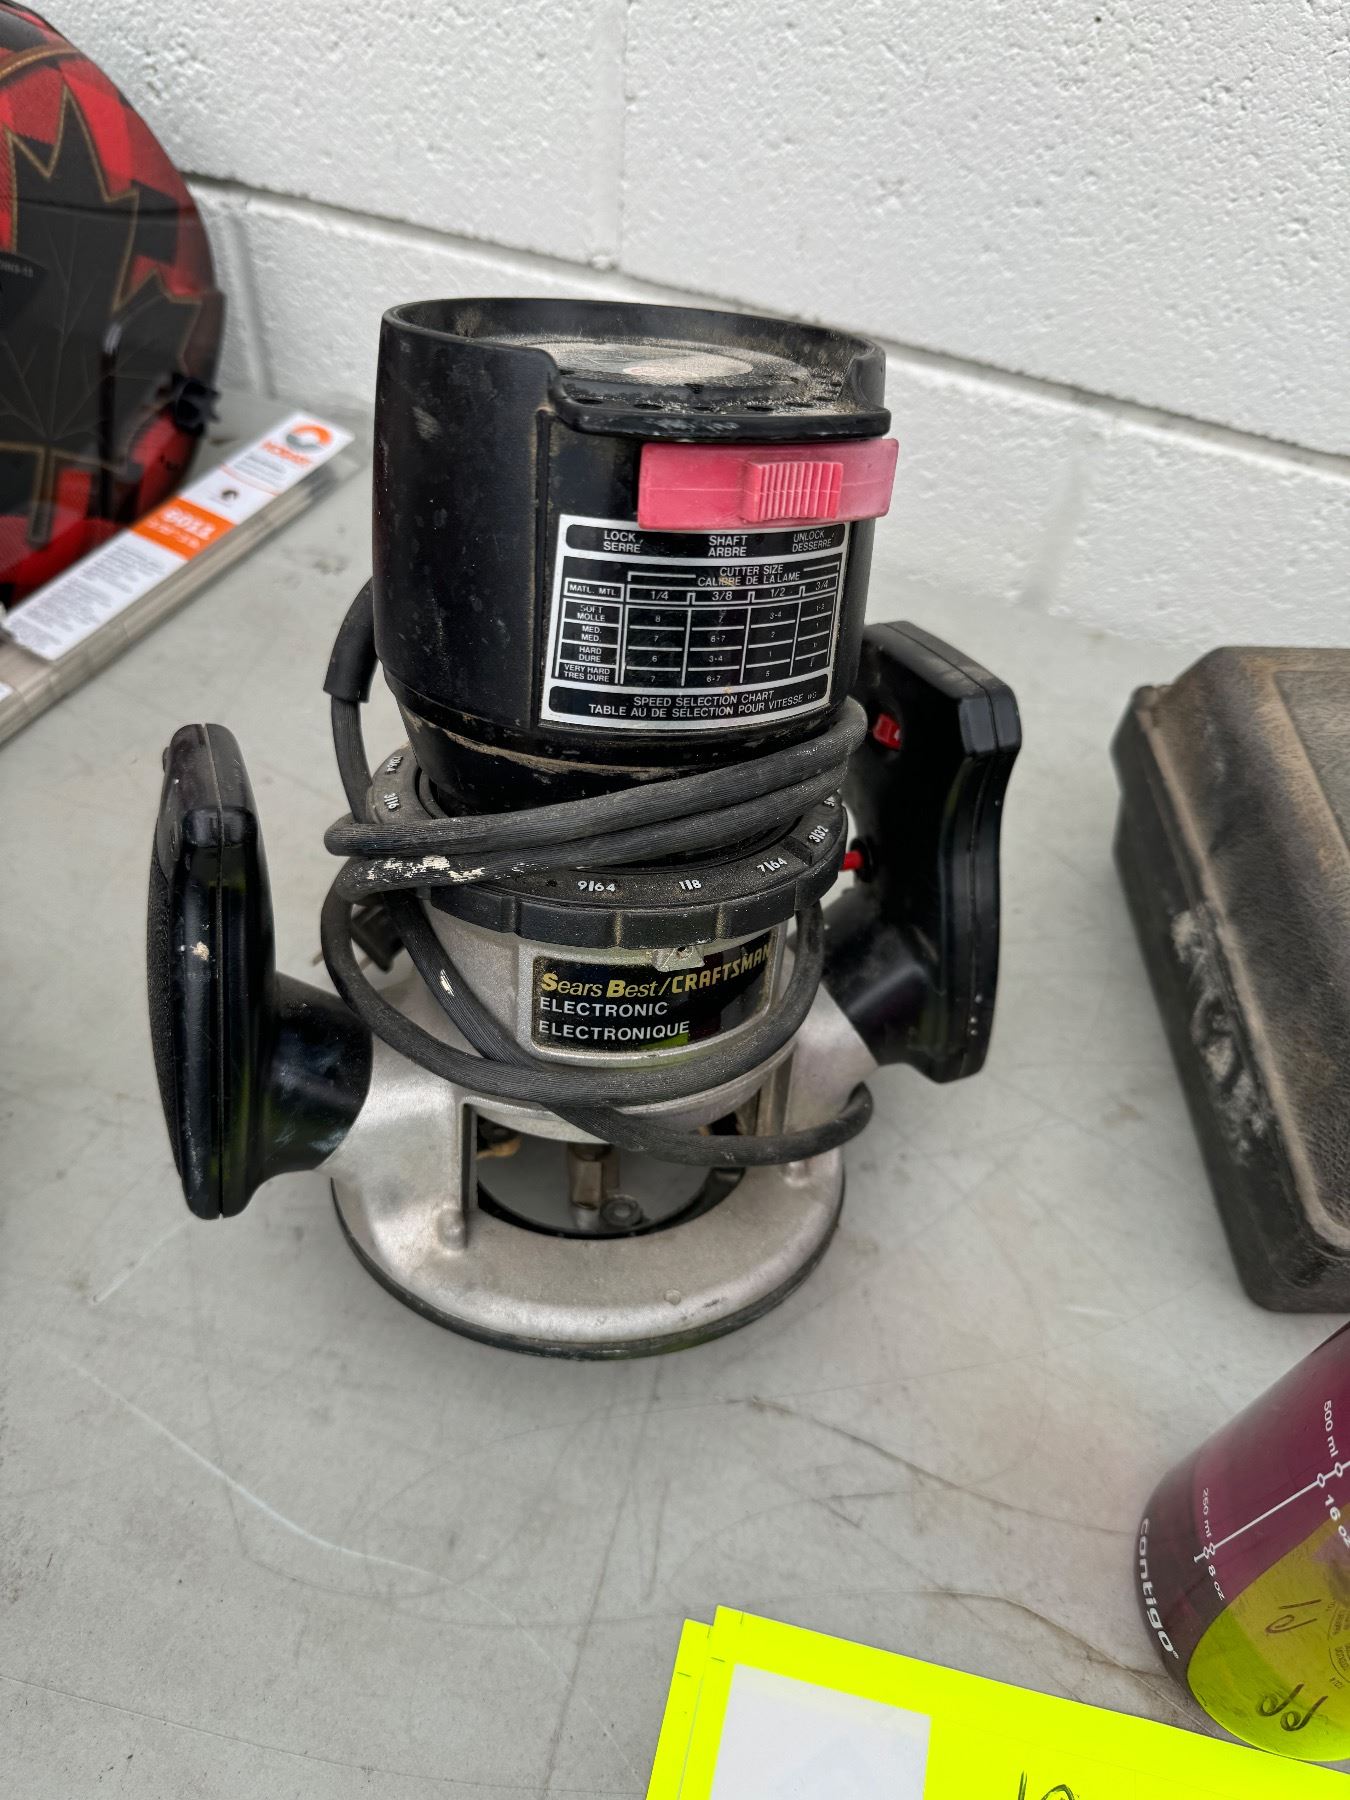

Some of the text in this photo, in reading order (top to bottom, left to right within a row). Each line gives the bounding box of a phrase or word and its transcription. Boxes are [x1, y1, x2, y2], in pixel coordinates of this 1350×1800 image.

[603, 530, 636, 542] LOCK
[708, 535, 748, 546] SHAFT
[793, 530, 825, 542] UNLOCK
[708, 547, 747, 557] ARBRE
[720, 564, 783, 577] CUTTER SIZE
[698, 571, 800, 587] CALIBRE DE LA LAME
[569, 584, 595, 595] MATL.
[816, 580, 829, 591] 3/4
[651, 590, 669, 600] 1/4
[712, 591, 733, 601] 3/8
[771, 588, 786, 598] 1/2
[580, 604, 603, 614] SOFT
[577, 613, 605, 622] MOLLE
[582, 625, 602, 634] MED.
[581, 633, 601, 642] MED.
[710, 635, 726, 643] 6-7
[579, 646, 602, 655] HARD
[578, 654, 601, 663] DURE
[709, 655, 723, 663] 3-4
[564, 663, 610, 675] VERY HARD
[563, 671, 610, 683] TRES DURE
[706, 675, 721, 683] 6-7
[633, 690, 774, 707] SPEED SELECTION CHART
[651, 708, 667, 718] DE
[738, 702, 765, 714] POUR
[768, 693, 804, 710] VITESSE
[541, 972, 603, 998] Sears
[539, 997, 669, 1018] ELECTRONIC
[539, 1020, 690, 1042] ELECTRONIQUE
[1323, 1400, 1339, 1458] 500 ml
[1324, 1493, 1341, 1522] 16
[1203, 1518, 1212, 1538] ml
[1208, 1564, 1225, 1600] 8 oz
